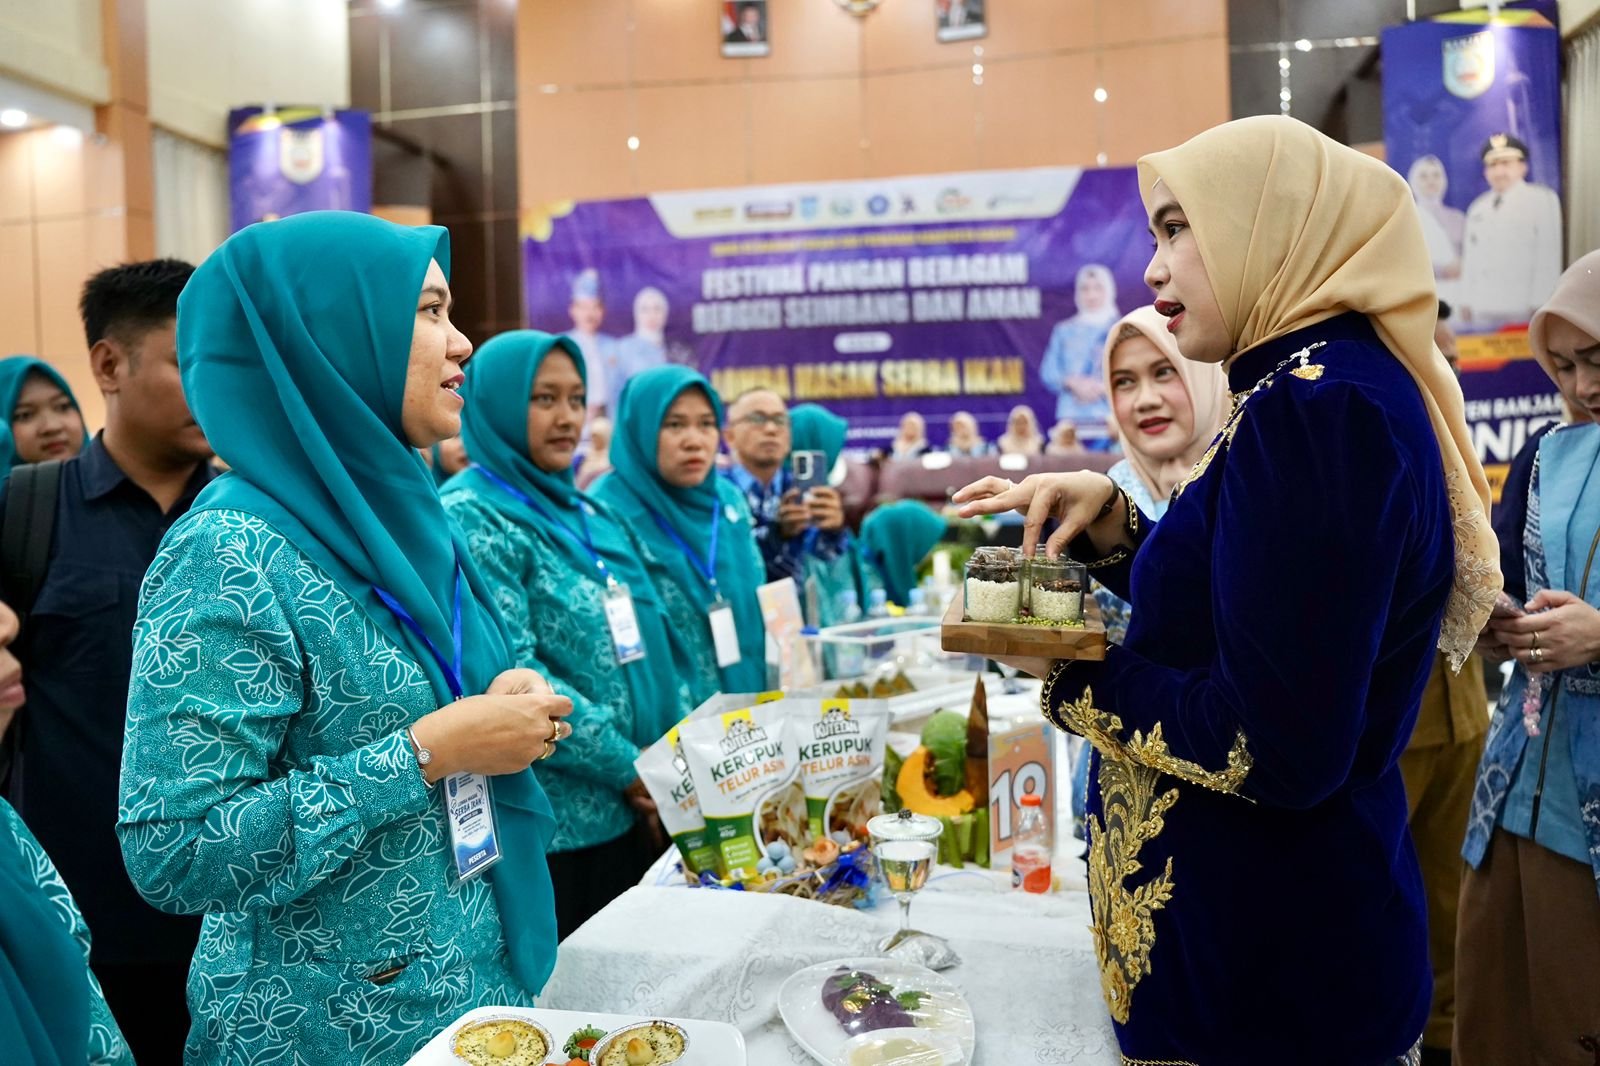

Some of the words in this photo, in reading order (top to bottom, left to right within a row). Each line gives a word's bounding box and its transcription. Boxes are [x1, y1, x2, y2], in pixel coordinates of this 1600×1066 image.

[809, 258, 904, 292] PANGAN
[908, 253, 1028, 287] BERAGAM
[785, 293, 909, 328] SEIMBANG
[913, 290, 964, 323] DAN
[967, 286, 1041, 320] AMAN
[794, 362, 878, 399] MASAK
[881, 359, 960, 396] SERBA
[963, 357, 1024, 394] IKAN
[711, 742, 784, 782] KERUPUK
[799, 738, 873, 762] KERUPUK
[801, 756, 844, 777] TELUR
[717, 765, 761, 796] TELUR
